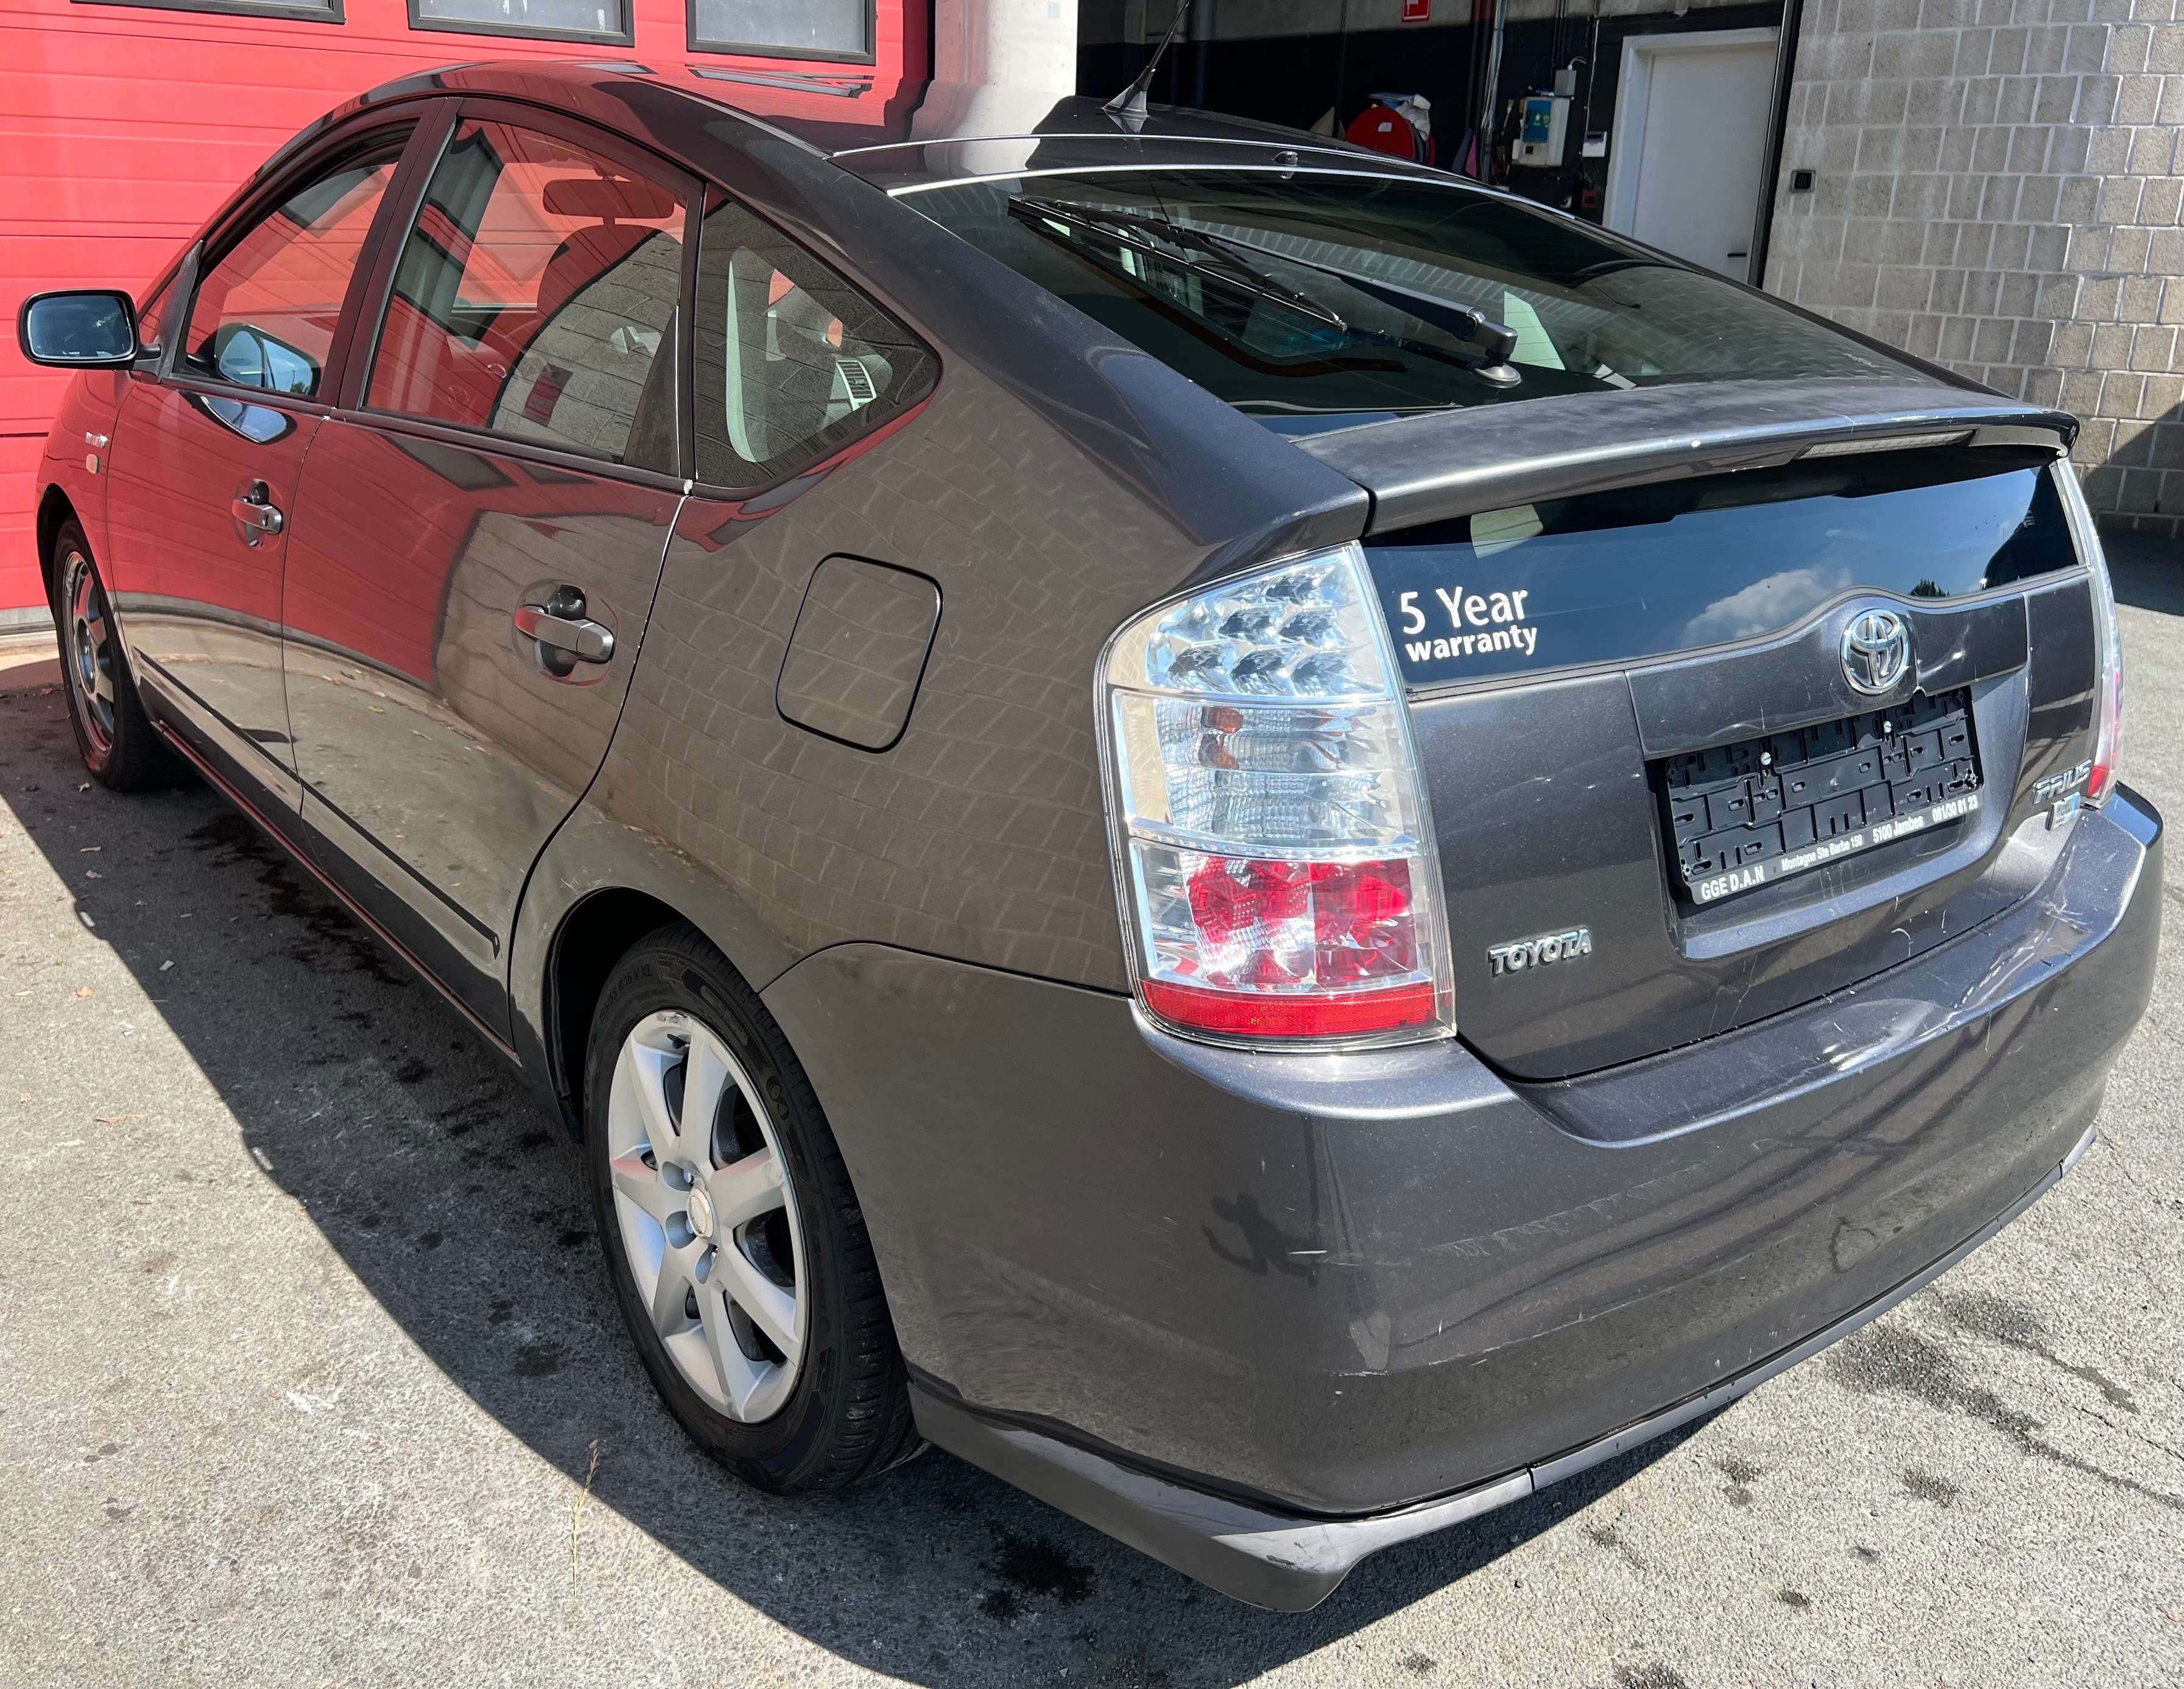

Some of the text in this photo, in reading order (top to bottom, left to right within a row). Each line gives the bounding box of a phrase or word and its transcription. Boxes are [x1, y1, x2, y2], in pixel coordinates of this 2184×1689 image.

[1401, 586, 1528, 634] 5 Year
[1405, 624, 1537, 662] warranty
[2032, 759, 2091, 804] PRIUS
[1701, 877, 1728, 900] GGE
[1730, 865, 1765, 891] D.A.N
[1781, 851, 1817, 871] Montagne
[1817, 846, 1830, 860] Ste
[1830, 840, 1850, 855] Barbe
[1850, 834, 1863, 848] 150
[1872, 823, 1892, 843] 5100
[1893, 815, 1924, 837] Jambes
[1967, 794, 1978, 810] 23
[641, 964, 653, 978] XL
[1488, 928, 1592, 975] TOYOTA
